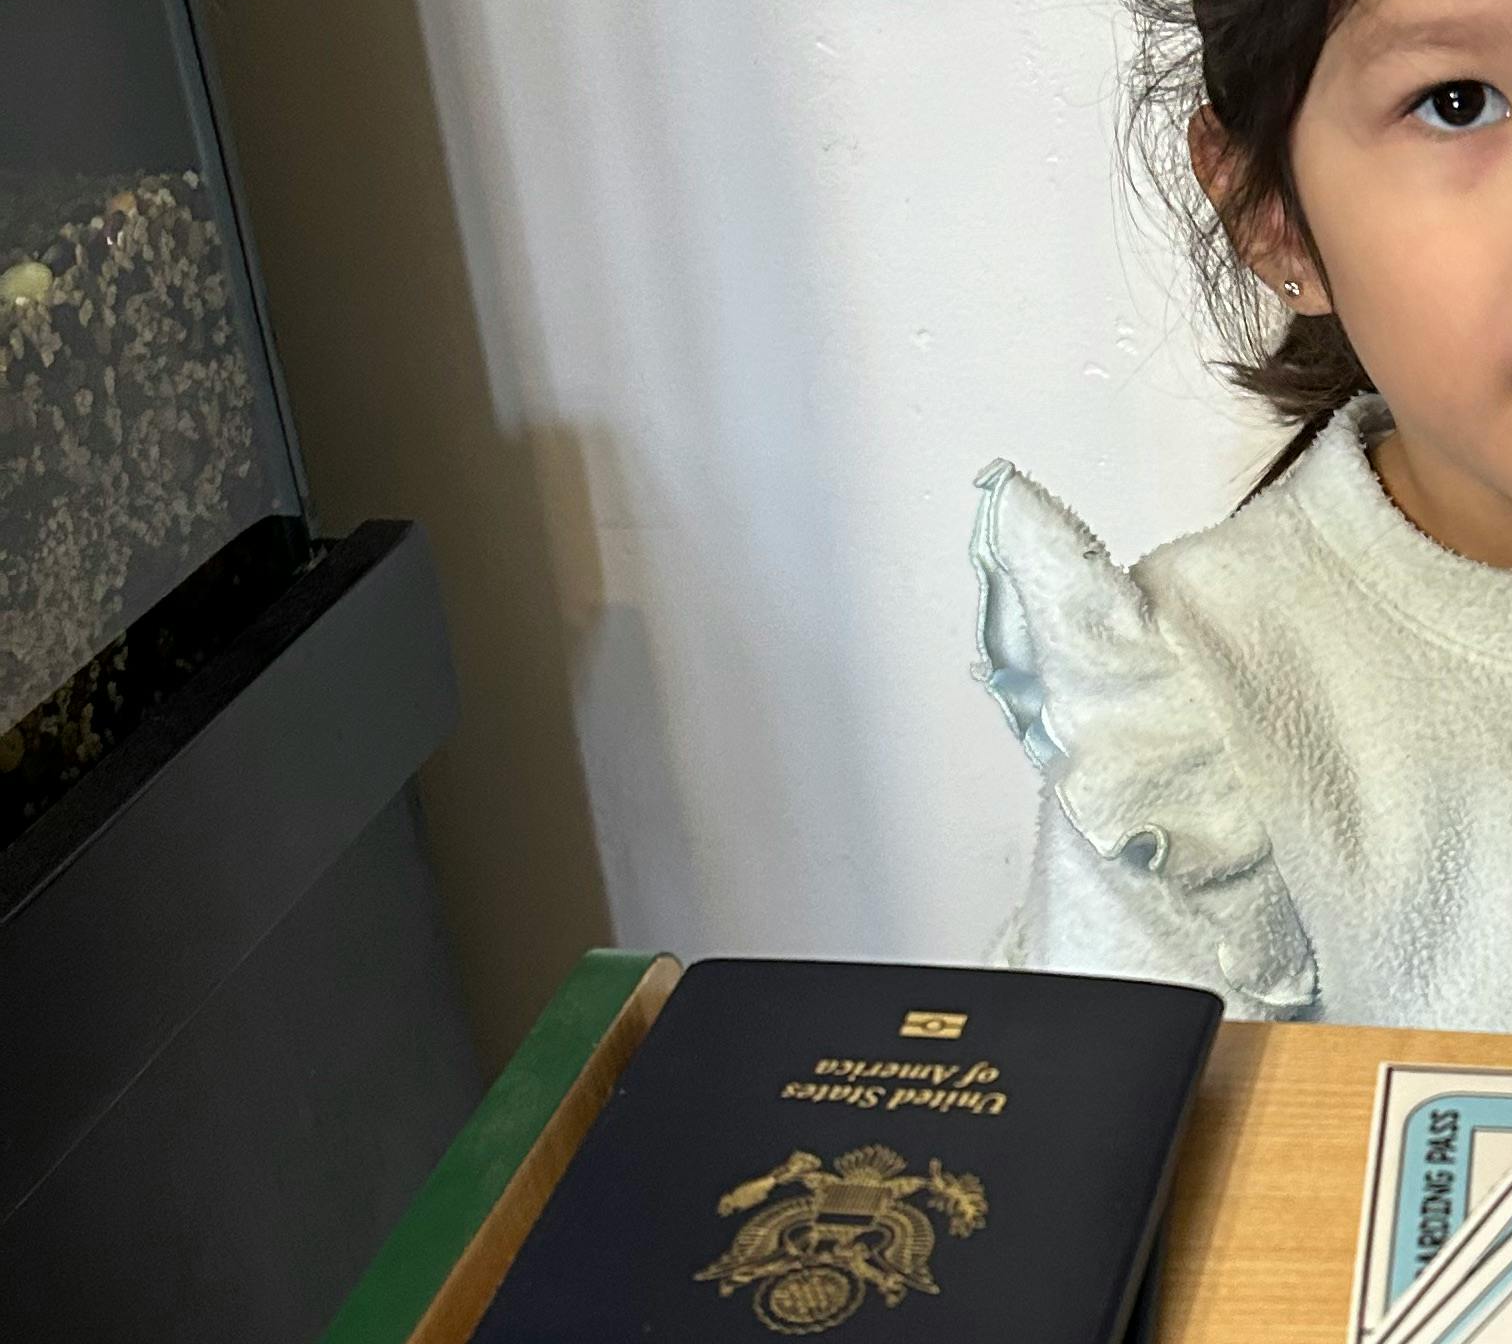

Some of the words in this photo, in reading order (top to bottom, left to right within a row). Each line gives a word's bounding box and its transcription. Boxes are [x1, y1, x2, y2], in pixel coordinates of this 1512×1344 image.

[813, 1058, 960, 1086] America
[952, 1060, 1001, 1089] of
[780, 1081, 888, 1109] States
[886, 1087, 1008, 1115] United
[1426, 1107, 1461, 1166] PASS
